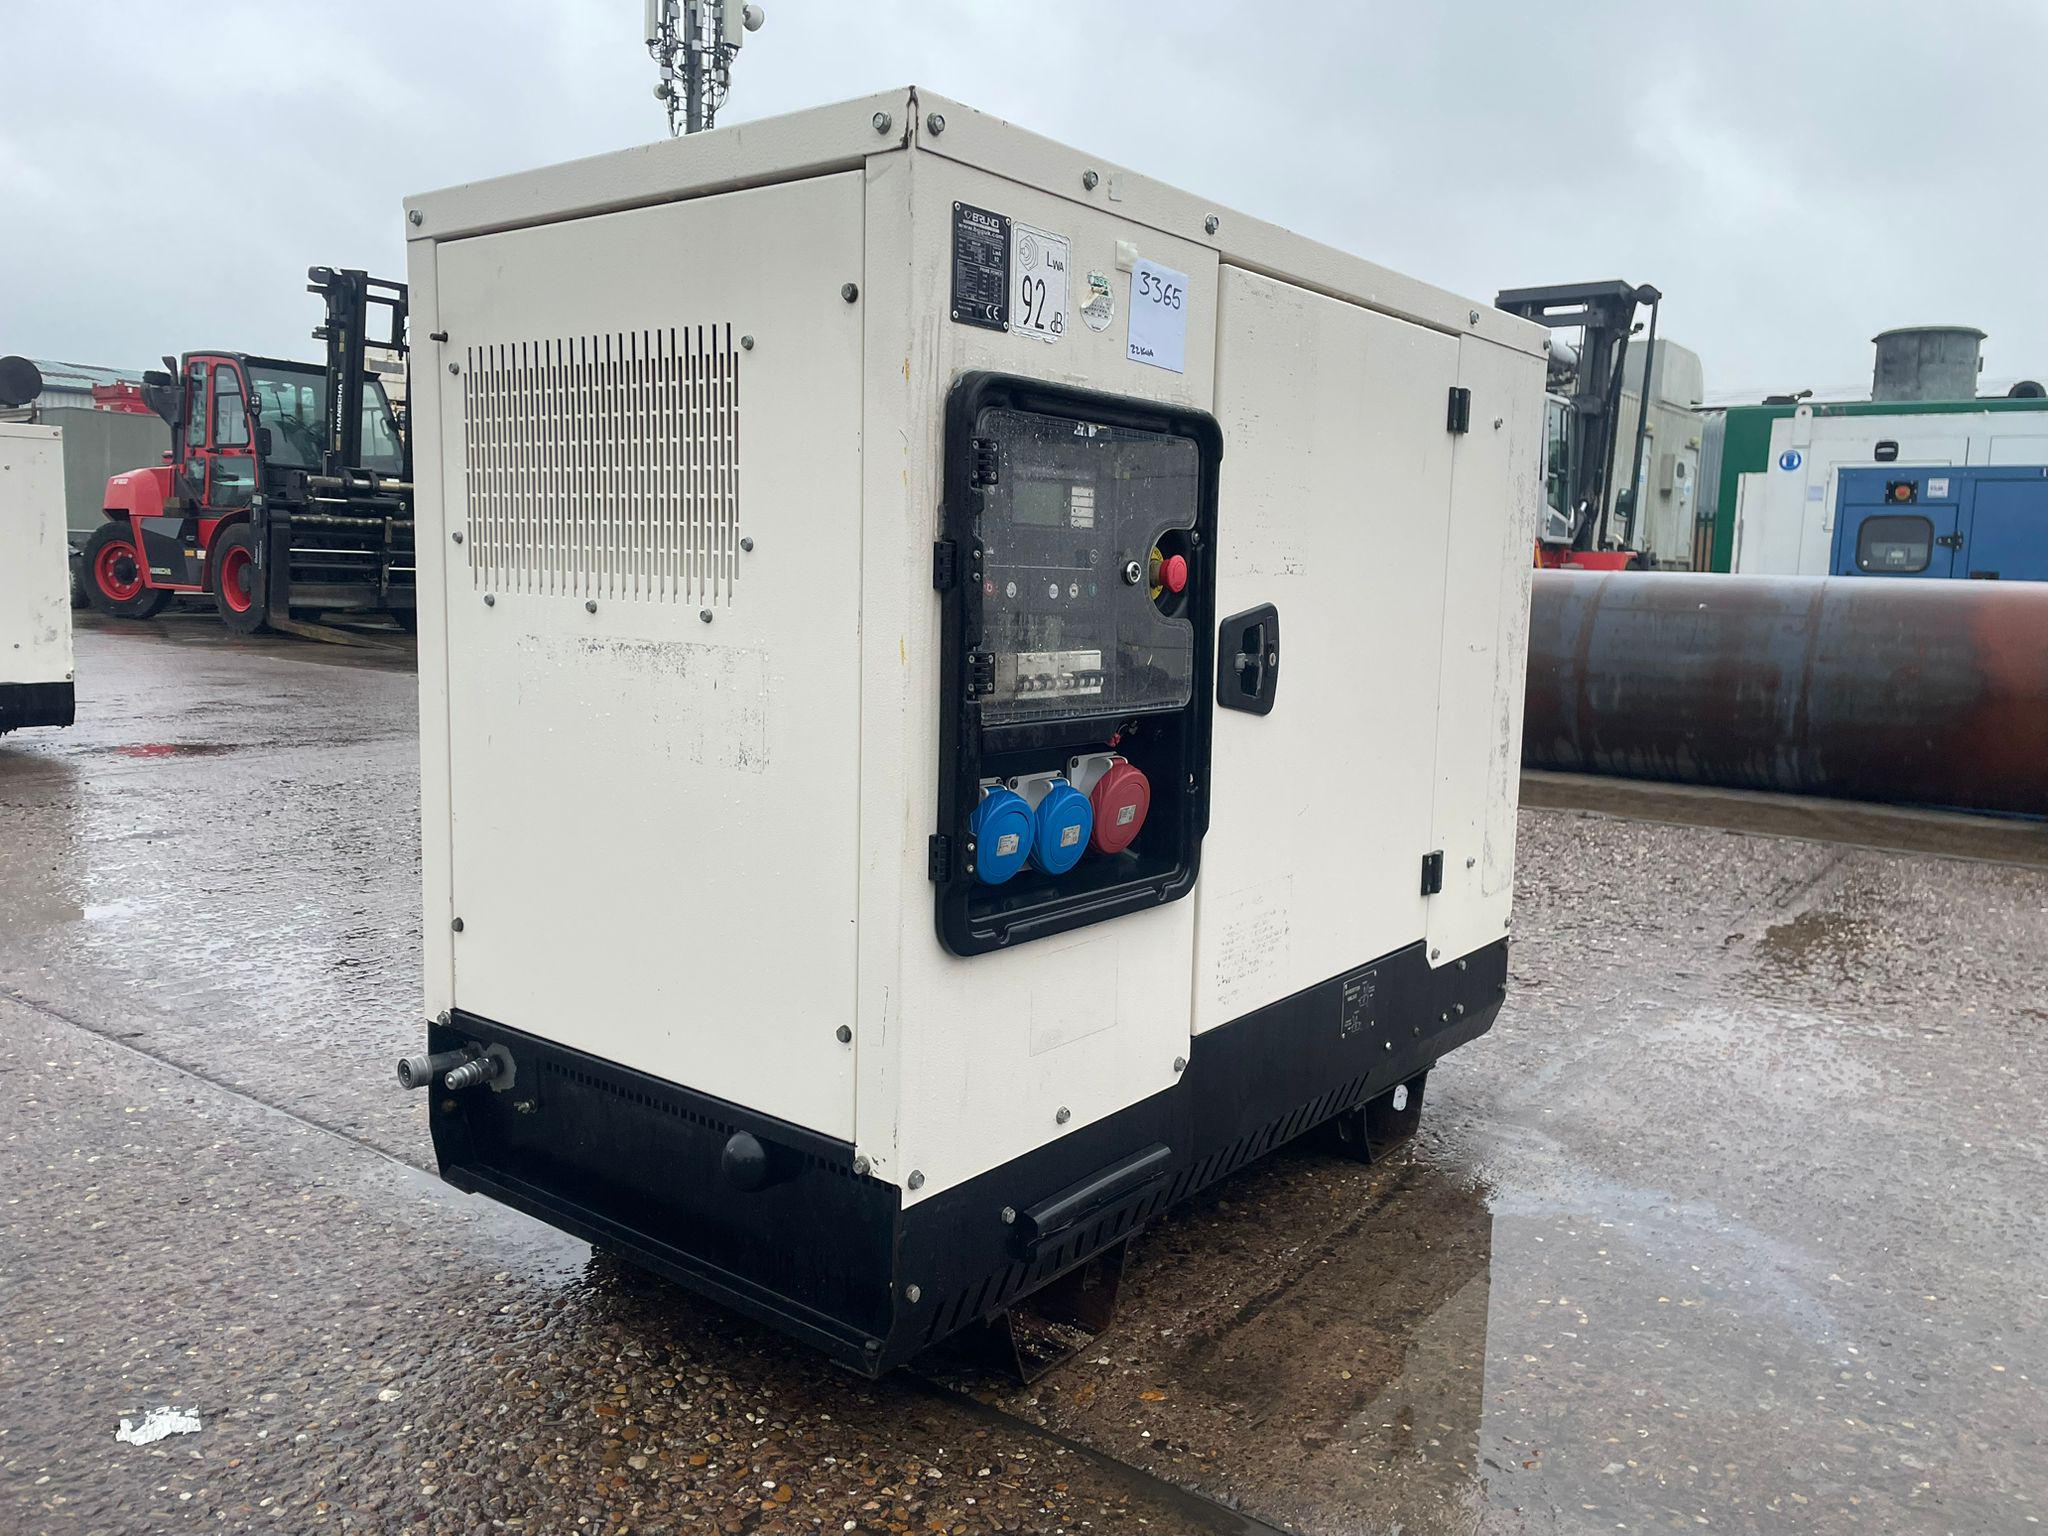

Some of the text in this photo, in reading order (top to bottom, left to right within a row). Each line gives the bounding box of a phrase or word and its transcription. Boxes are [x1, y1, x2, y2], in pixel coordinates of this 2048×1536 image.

[972, 212, 999, 228] BRUNO
[1022, 274, 1046, 330] 92
[1139, 271, 1183, 310] 3365
[1050, 311, 1064, 333] dB
